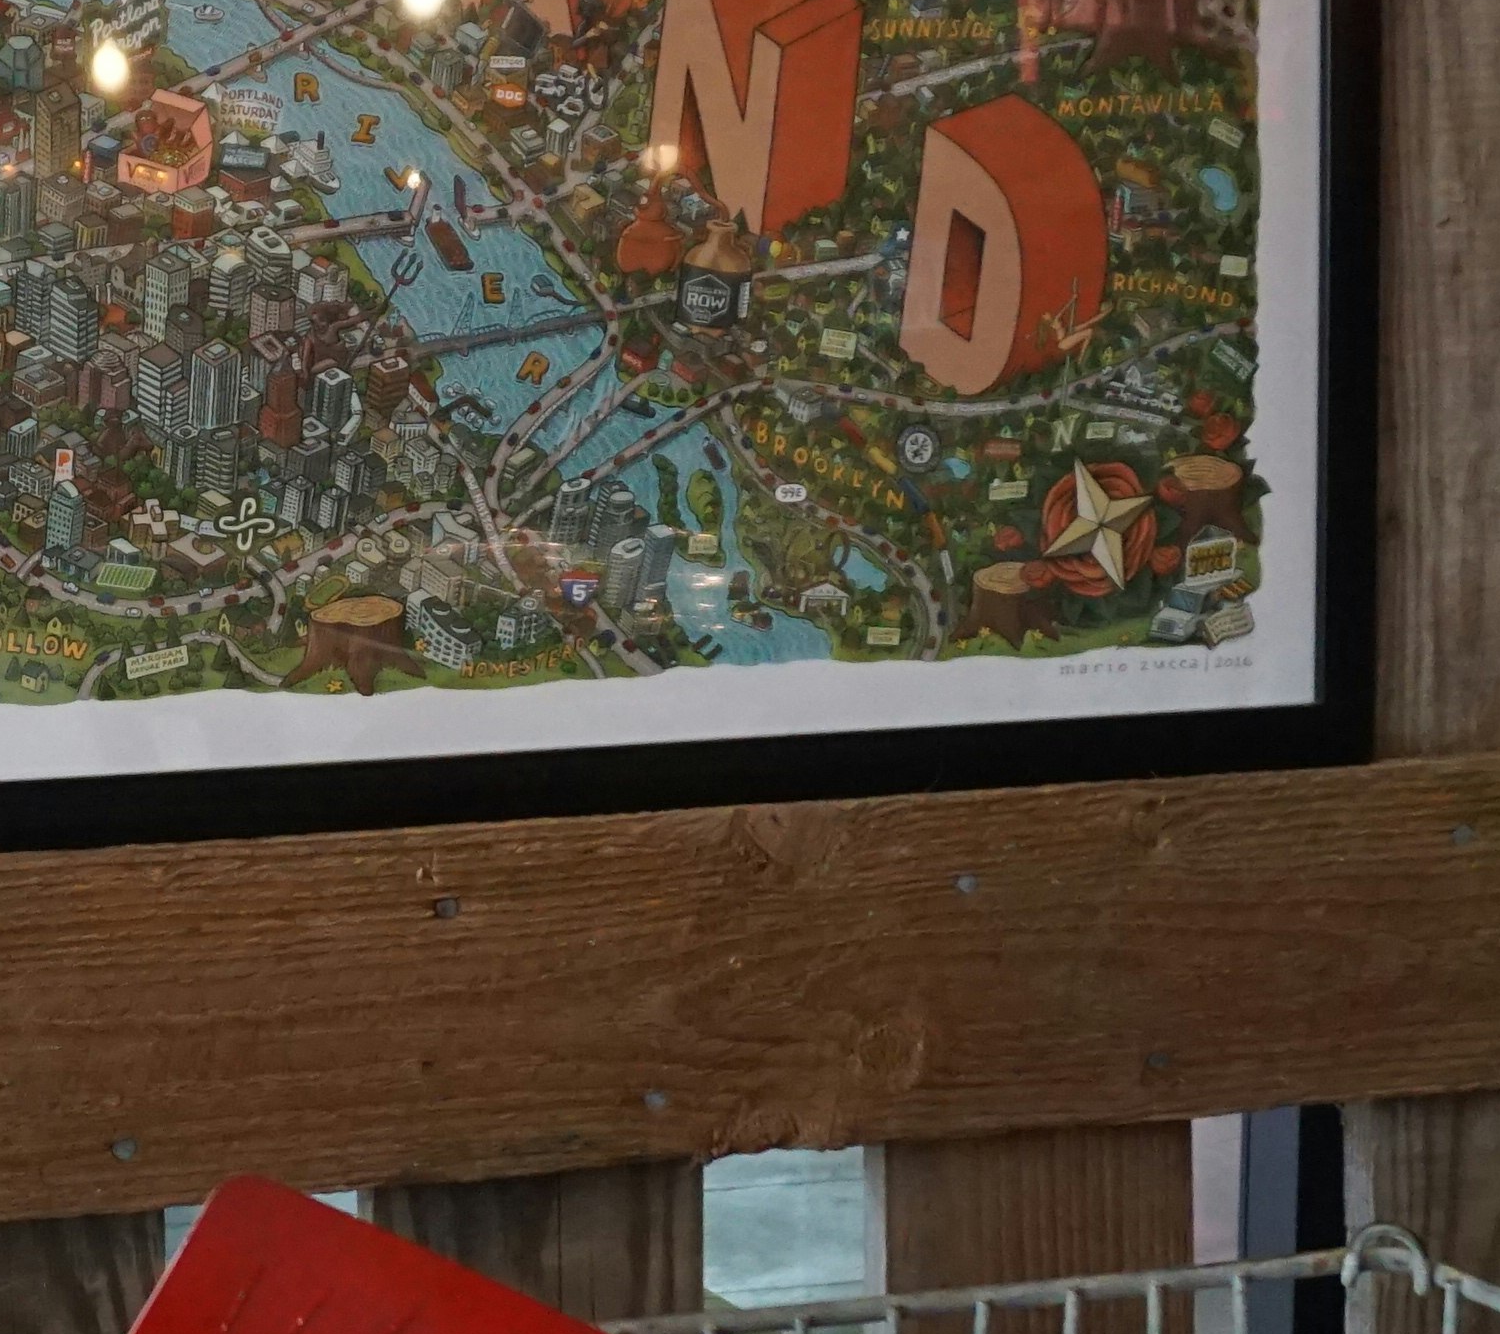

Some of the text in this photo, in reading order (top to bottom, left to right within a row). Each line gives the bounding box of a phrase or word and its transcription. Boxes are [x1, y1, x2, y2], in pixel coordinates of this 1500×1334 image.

[1057, 93, 1226, 119] MONTAVILLA
[684, 291, 728, 309] ROW
[1111, 272, 1237, 309] RICHMOND
[755, 420, 906, 509] BROOKLYN
